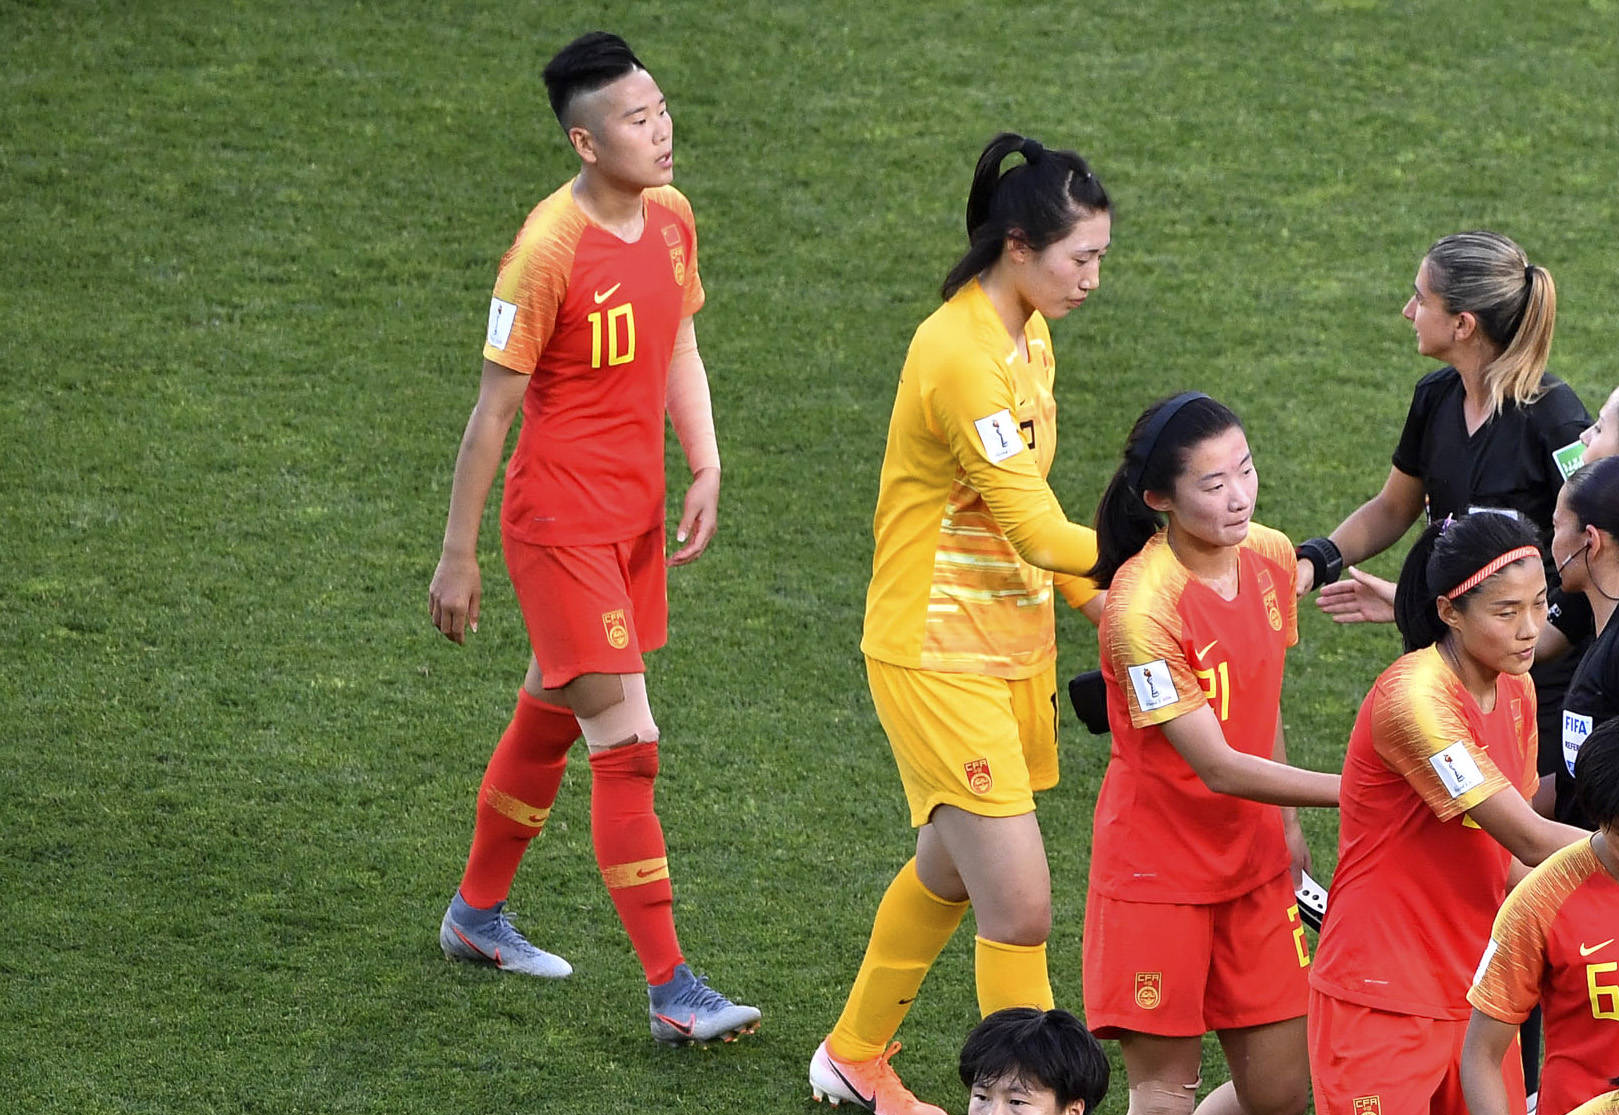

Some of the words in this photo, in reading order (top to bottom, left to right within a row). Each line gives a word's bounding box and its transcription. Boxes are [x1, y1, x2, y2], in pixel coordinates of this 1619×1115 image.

[588, 303, 636, 369] 10
[1565, 715, 1588, 735] FIFA
[965, 759, 987, 772] CFA
[1137, 974, 1160, 983] CFA
[1355, 1098, 1378, 1108] CFA
